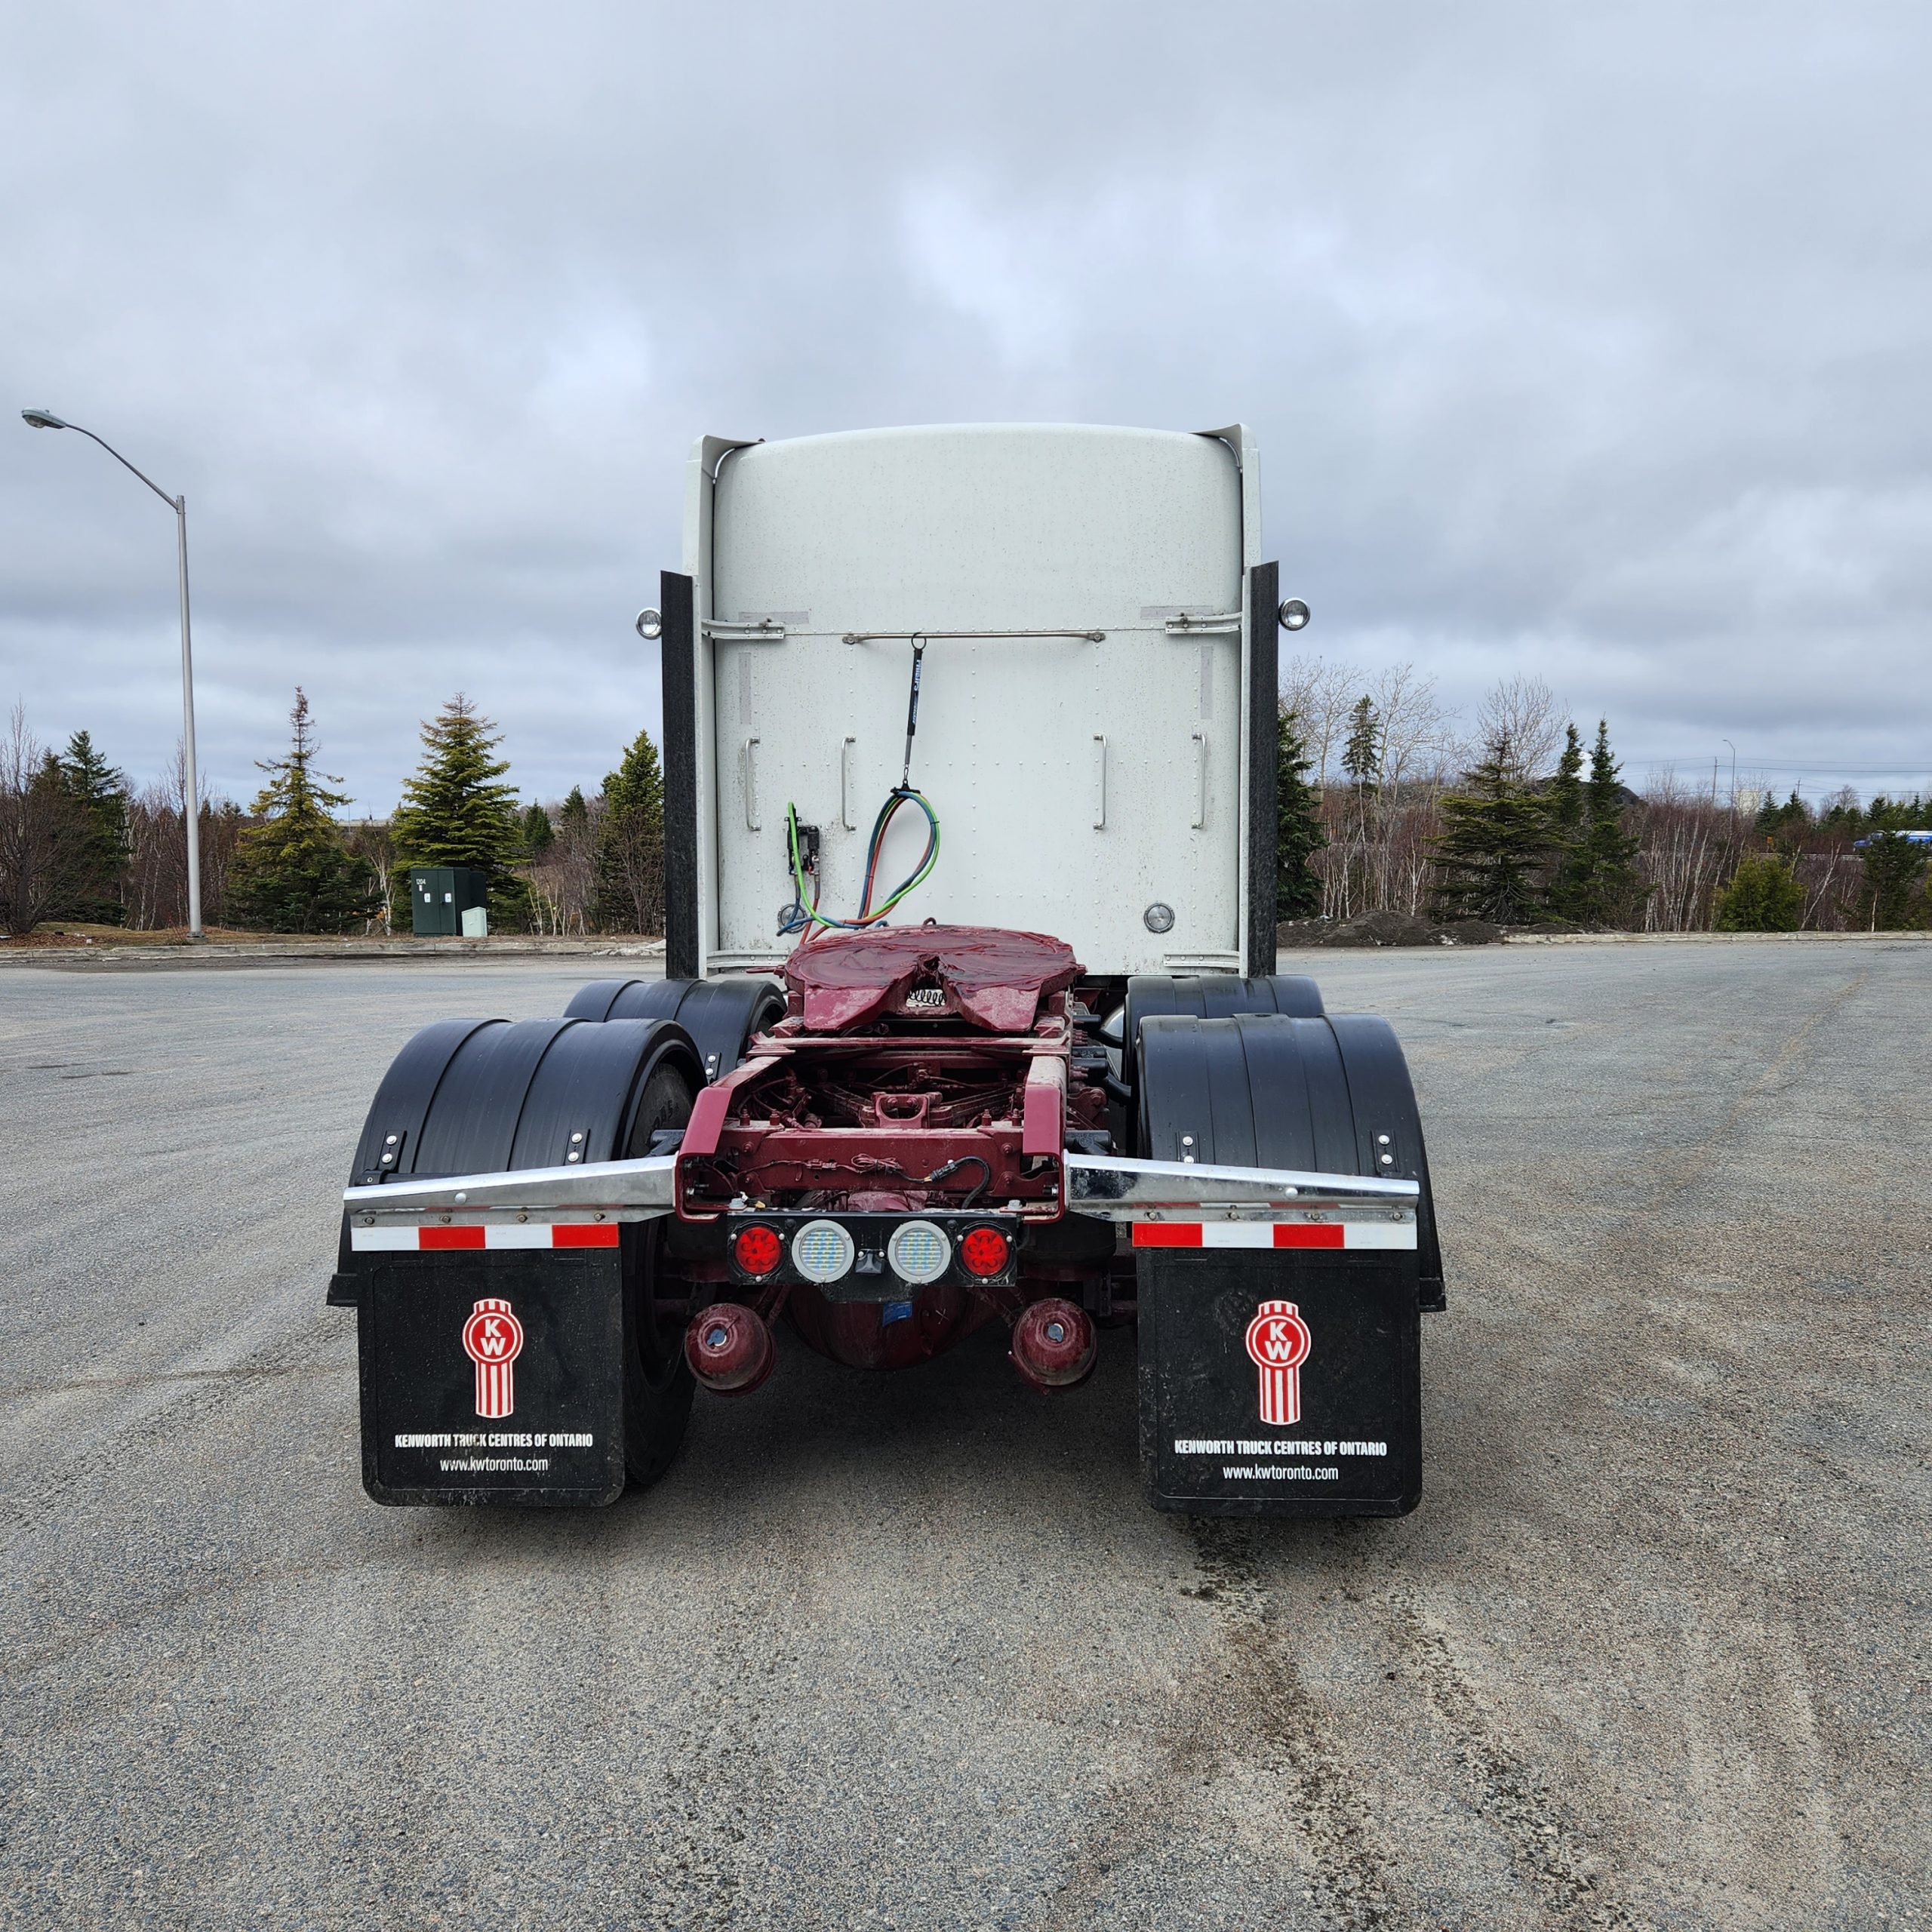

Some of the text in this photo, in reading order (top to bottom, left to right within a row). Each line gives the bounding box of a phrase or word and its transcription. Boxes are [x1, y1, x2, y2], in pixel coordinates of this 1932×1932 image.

[395, 1433, 593, 1447] KENWORTH TRUCK CENTRES OF ONTARIO
[1174, 1440, 1387, 1456] KENWORTH TRUCK CENTRES OF ONTARIO
[440, 1456, 548, 1472] www.kwtoronto.com
[1223, 1463, 1339, 1480] www.kwtoronto.com
